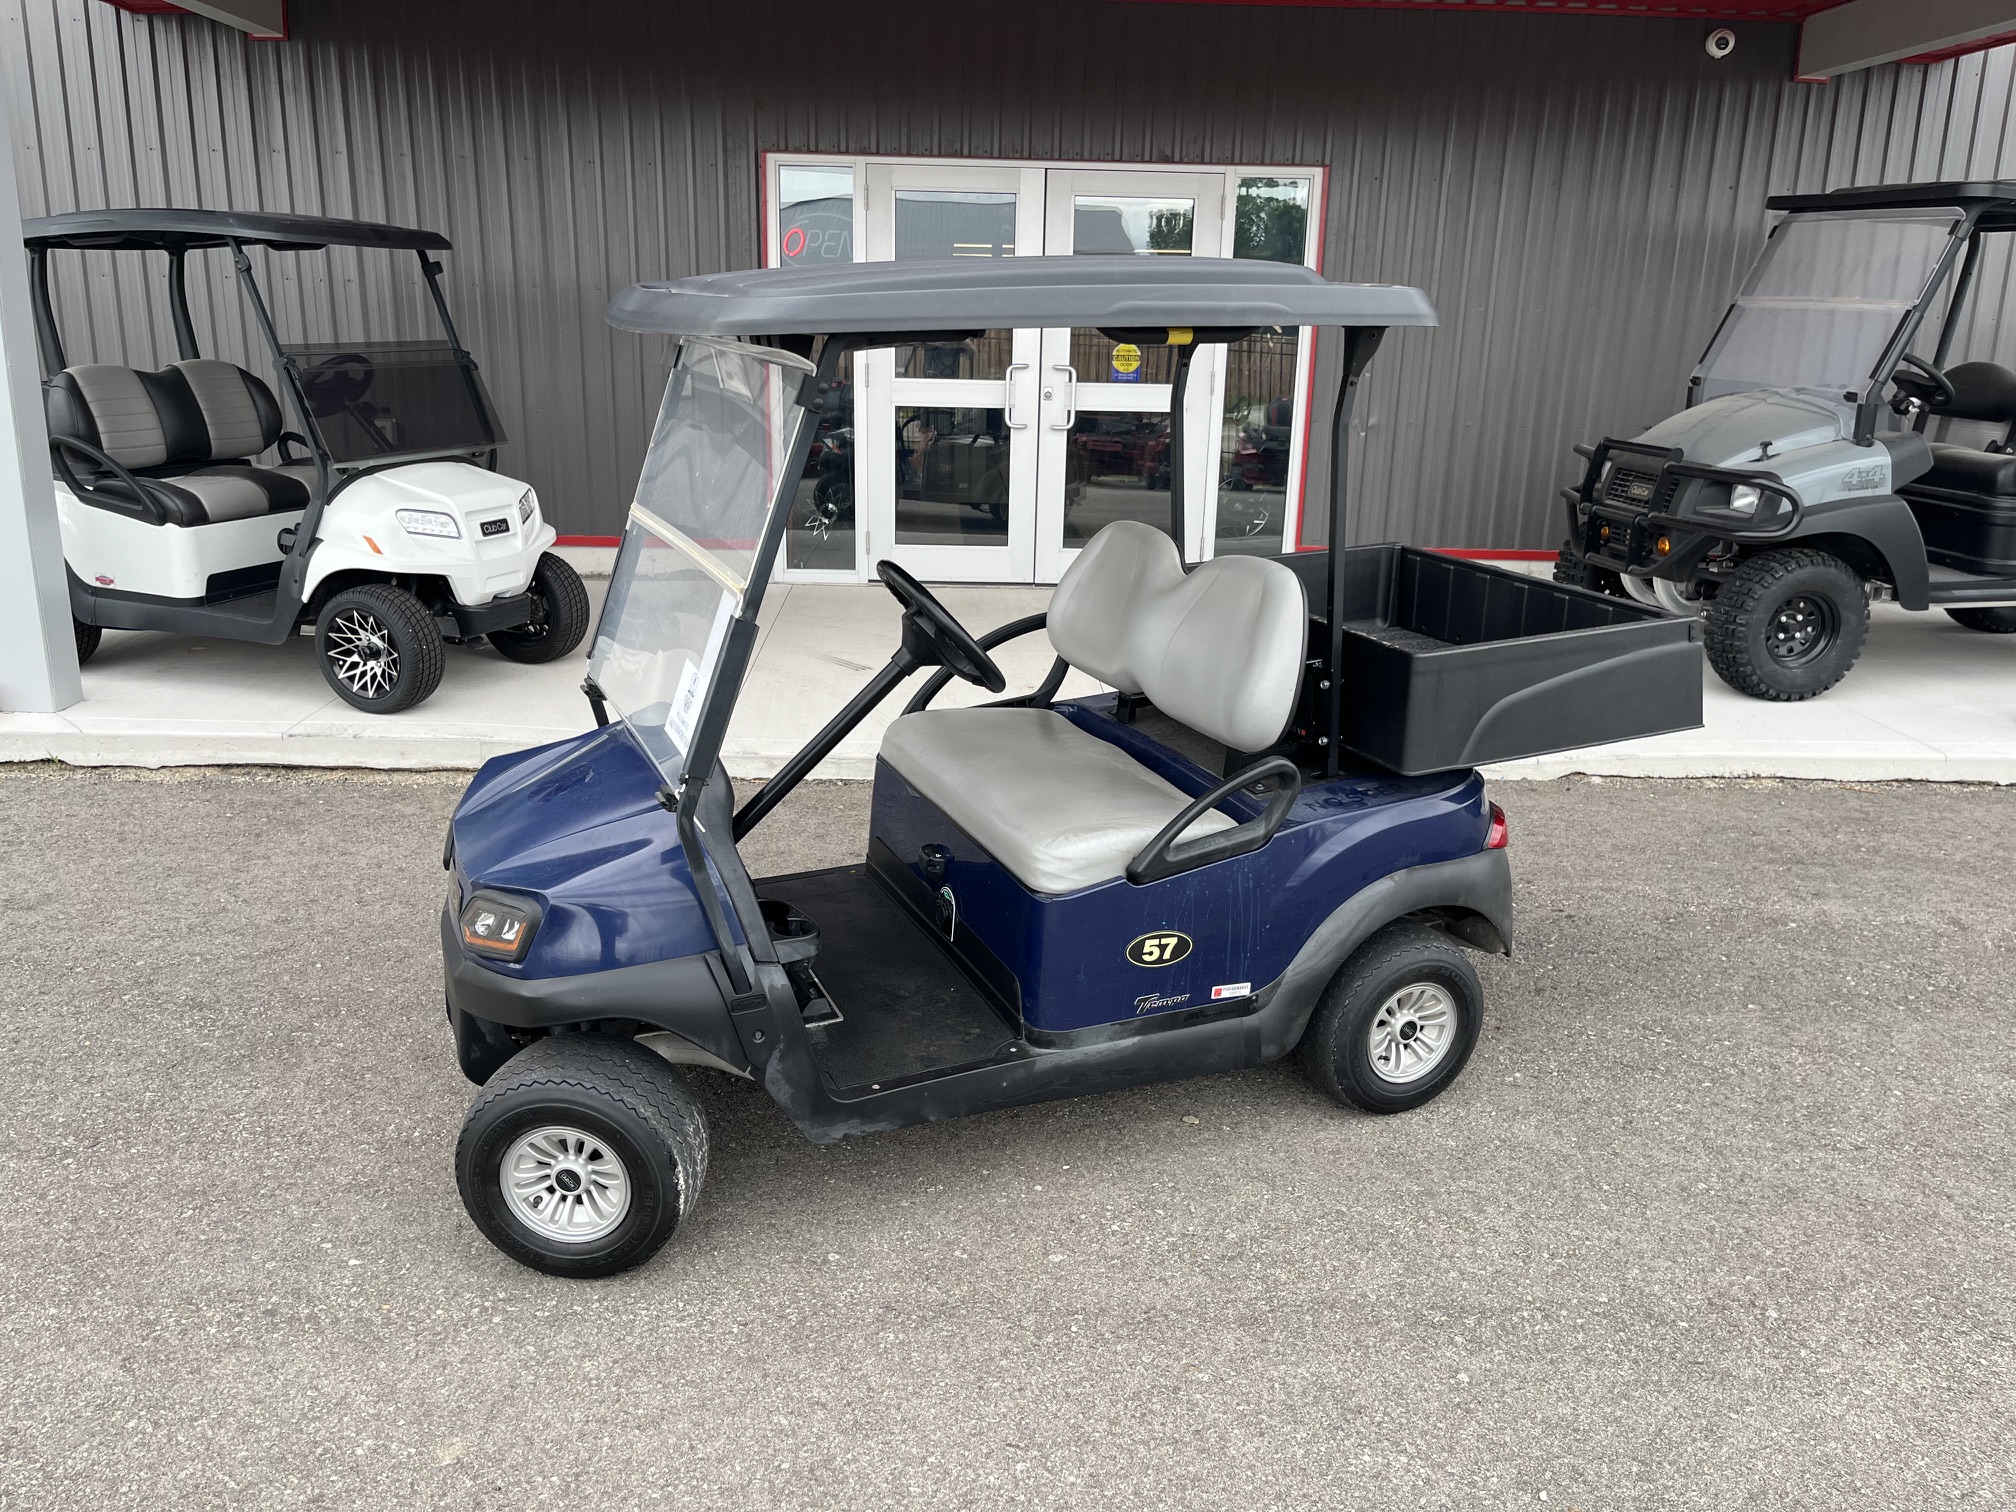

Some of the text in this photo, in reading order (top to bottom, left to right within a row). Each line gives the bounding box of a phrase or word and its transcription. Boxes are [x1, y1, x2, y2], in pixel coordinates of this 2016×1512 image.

[483, 522, 507, 533] Club Car
[1141, 936, 1178, 962] 57
